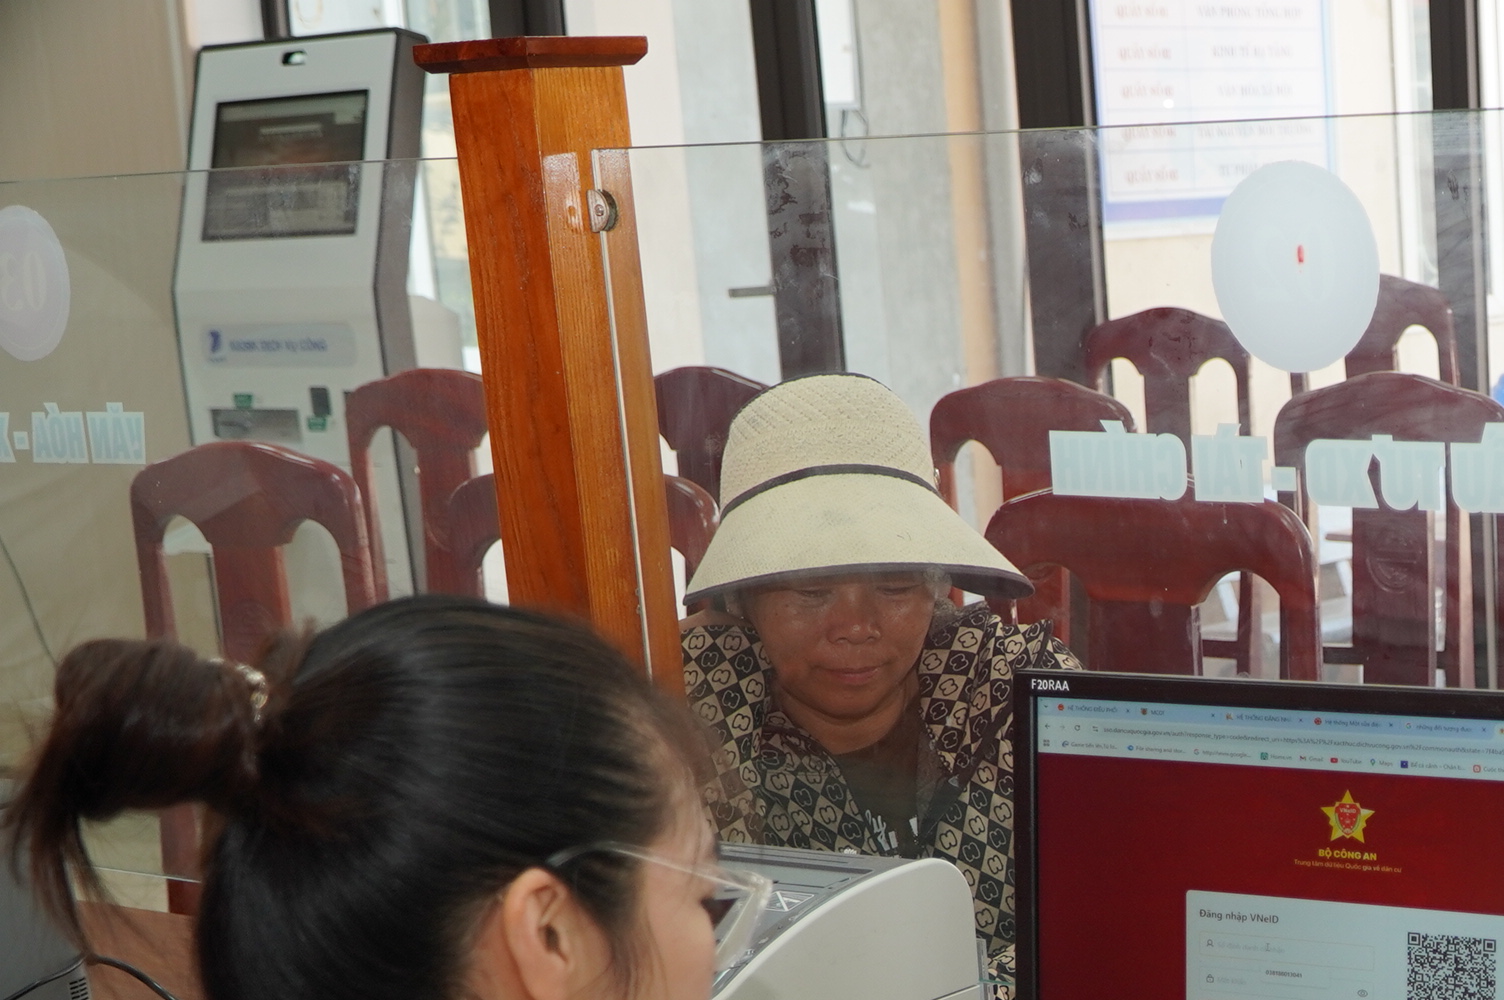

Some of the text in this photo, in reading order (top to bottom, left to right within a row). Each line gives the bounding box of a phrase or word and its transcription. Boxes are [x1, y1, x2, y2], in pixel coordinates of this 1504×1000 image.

[1031, 679, 1070, 692] F20RAA
[1318, 847, 1377, 861] BỘ CÔNG AN
[1294, 859, 1311, 867] Trung
[1199, 908, 1279, 924] Đăng nhập VNeID
